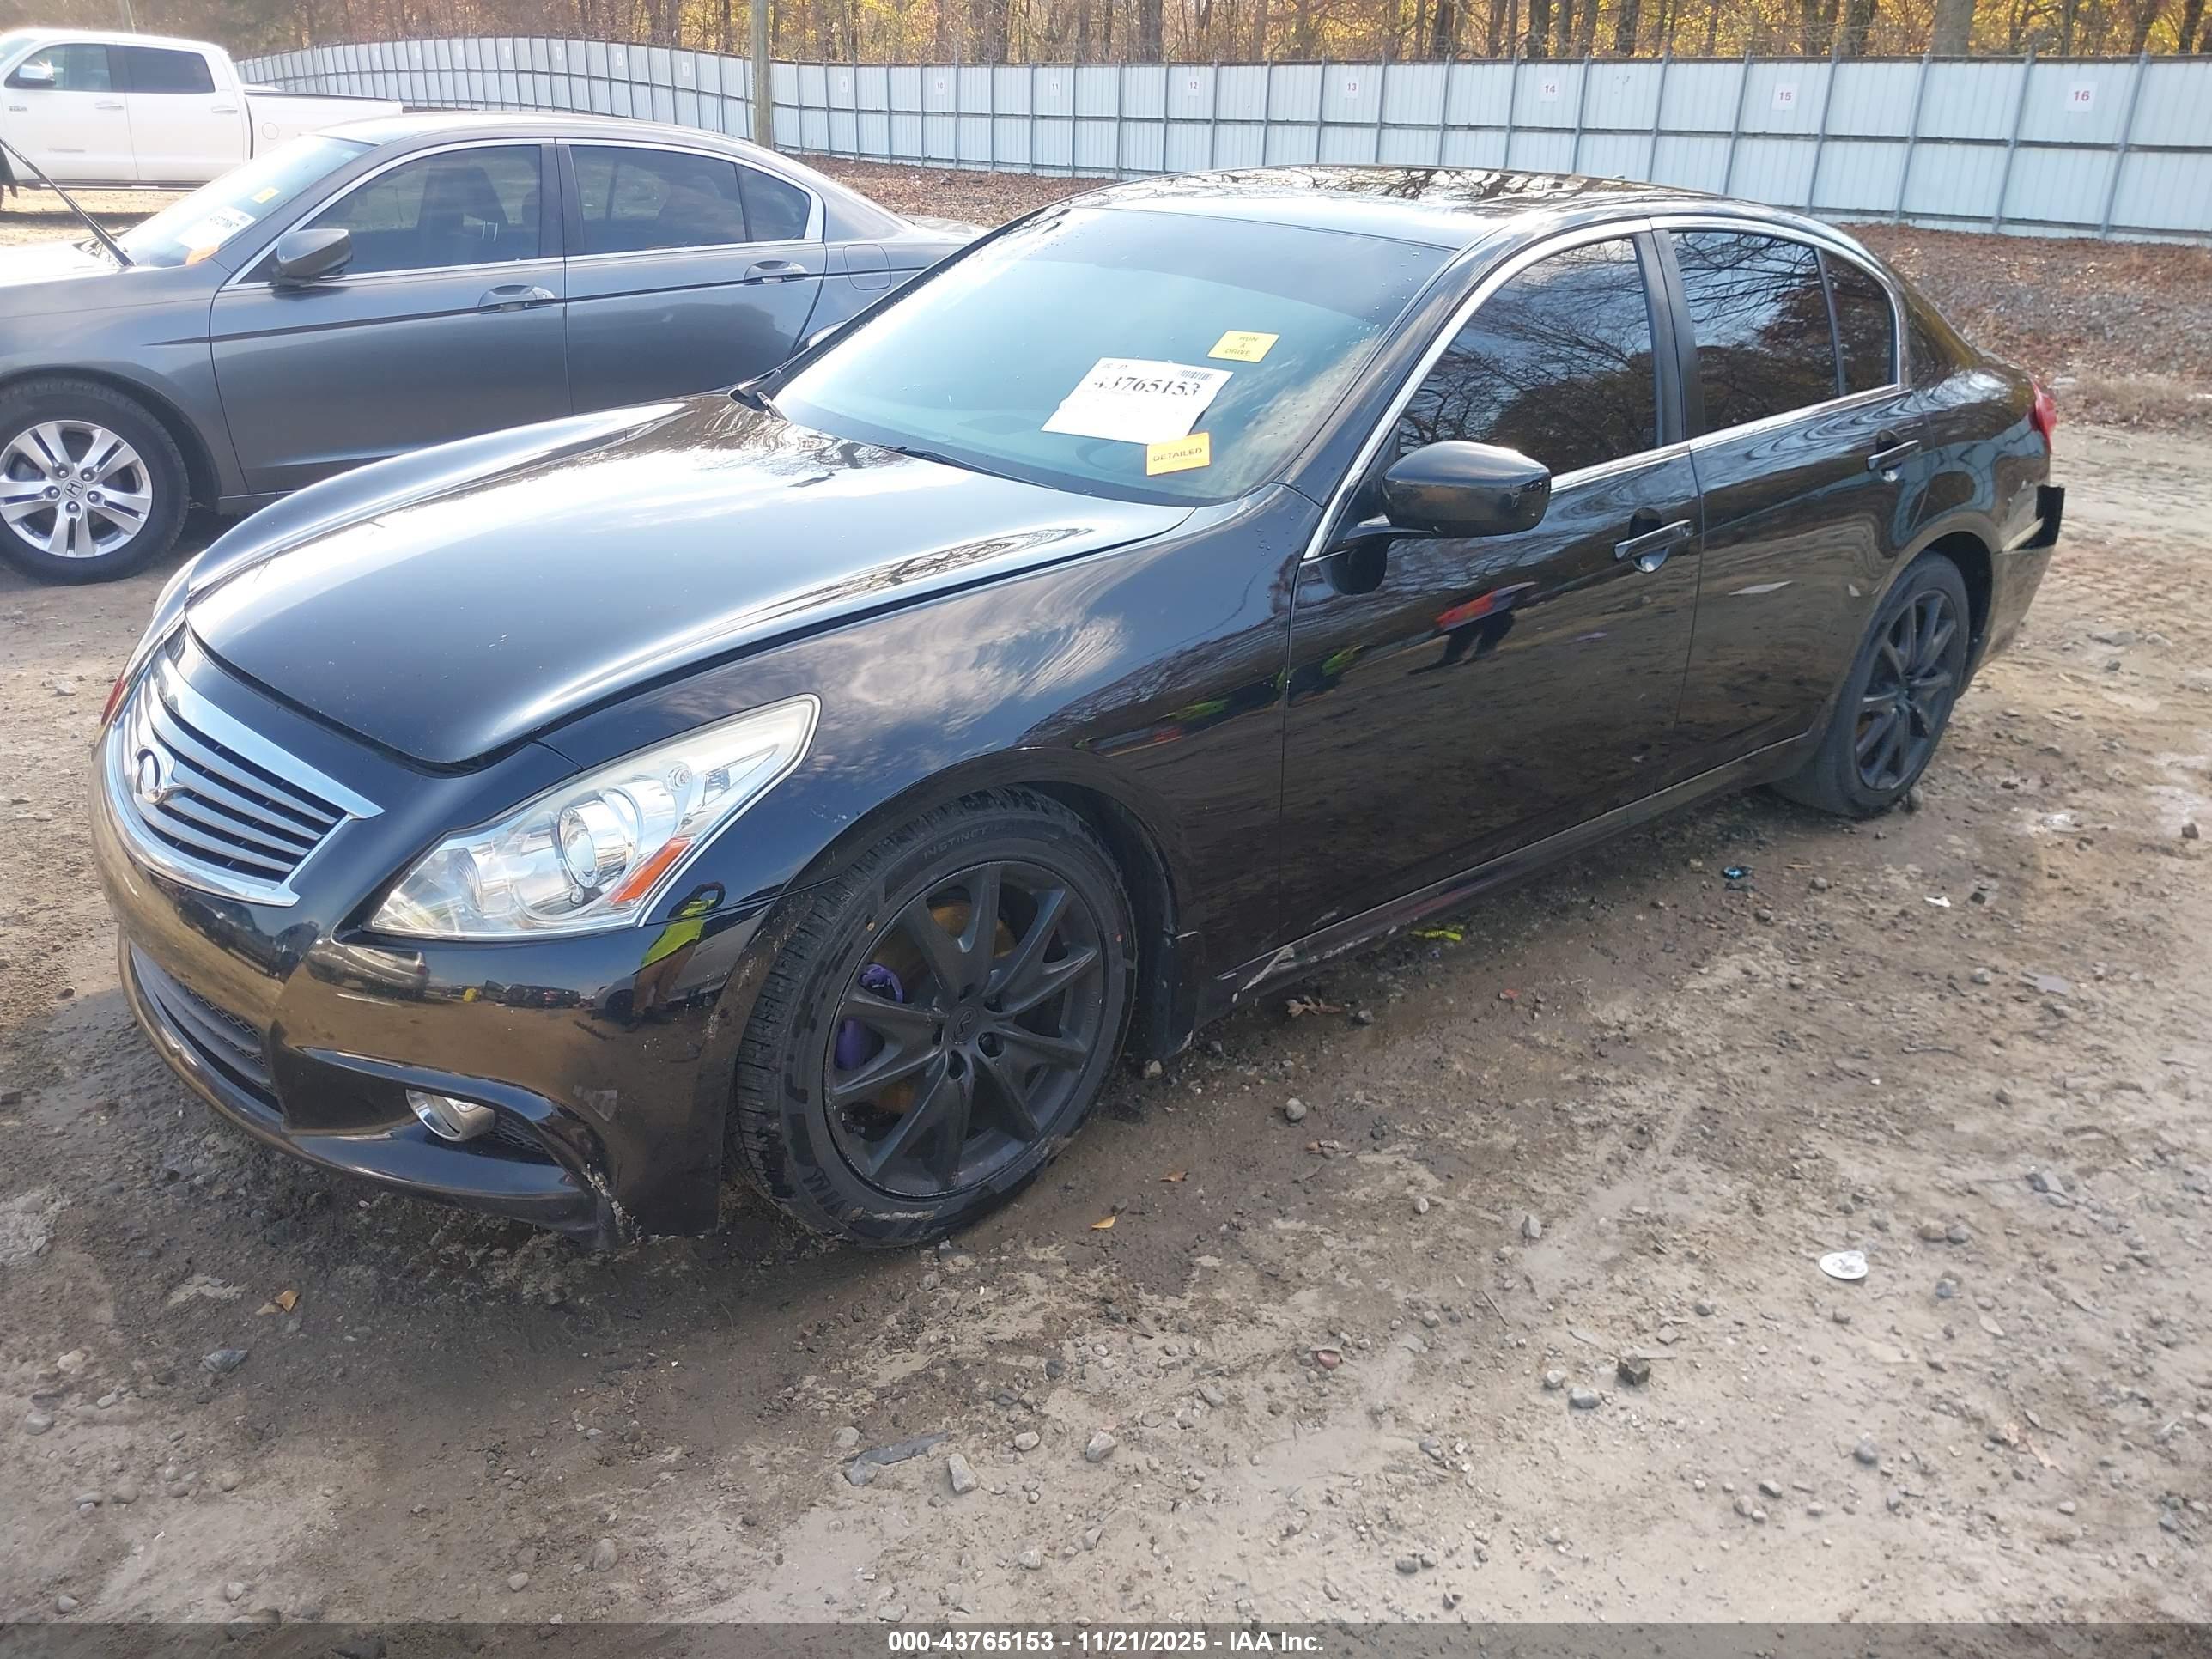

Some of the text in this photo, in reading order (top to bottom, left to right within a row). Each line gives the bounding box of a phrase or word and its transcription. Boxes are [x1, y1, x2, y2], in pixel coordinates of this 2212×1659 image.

[1189, 82, 1199, 90] 12
[1346, 82, 1358, 91] 13
[1544, 84, 1556, 94] 14
[1779, 91, 1792, 101] 15
[2074, 90, 2092, 102] 16
[1152, 447, 1203, 462] DETAILED
